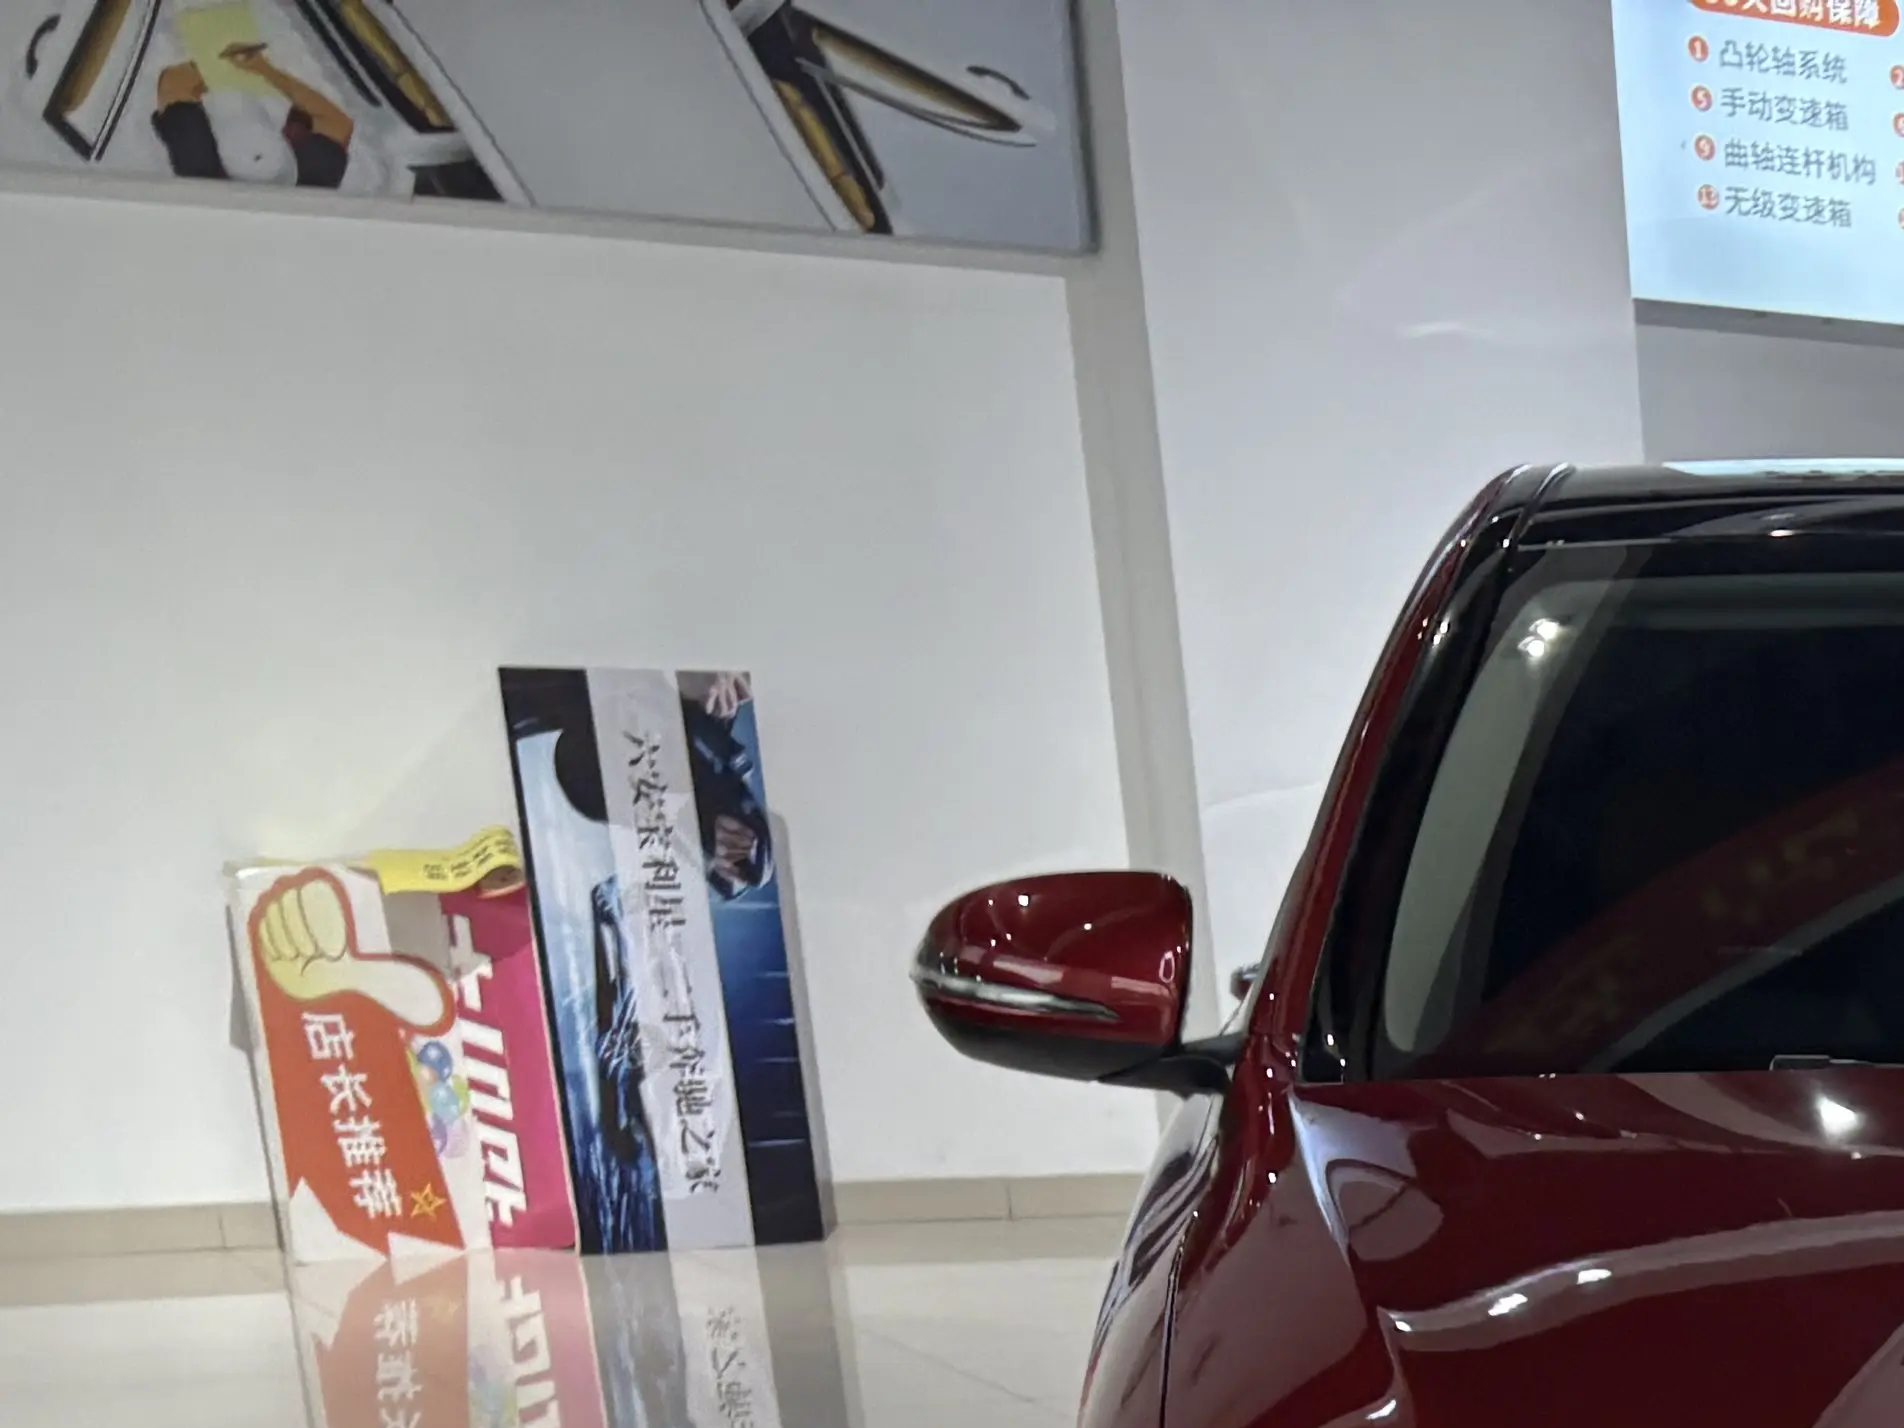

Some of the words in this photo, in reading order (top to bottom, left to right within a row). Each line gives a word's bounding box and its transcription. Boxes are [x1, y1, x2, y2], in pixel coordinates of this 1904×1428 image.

[1719, 41, 1848, 84] 凸轮轴系统
[1721, 87, 1849, 131] 手动变速箱
[1724, 187, 1852, 228] 无级变速箱
[301, 1011, 403, 1219] 店长推荐
